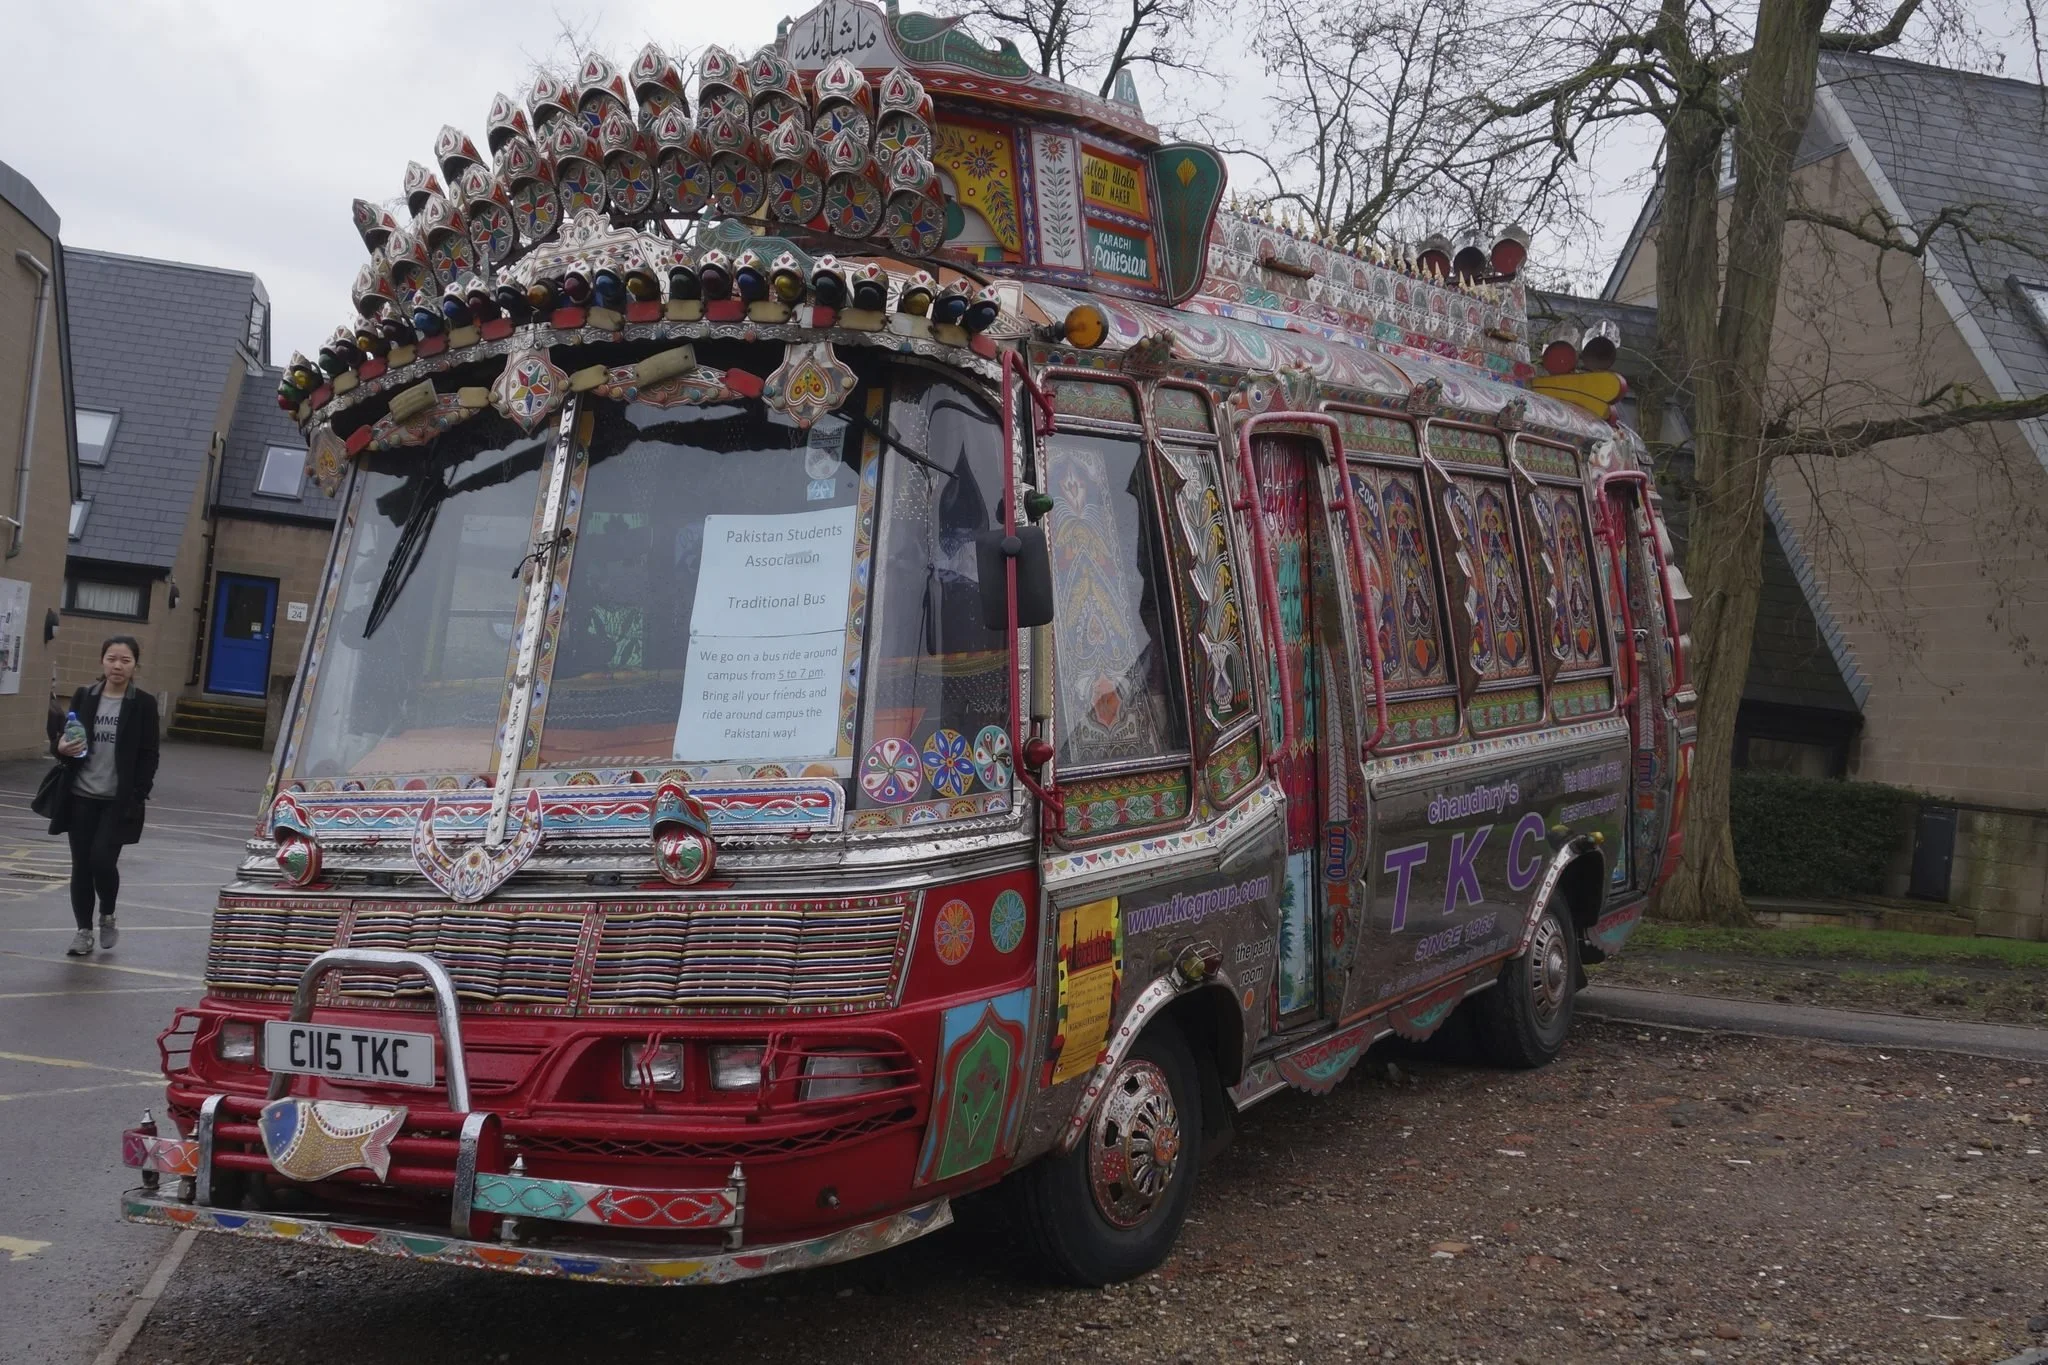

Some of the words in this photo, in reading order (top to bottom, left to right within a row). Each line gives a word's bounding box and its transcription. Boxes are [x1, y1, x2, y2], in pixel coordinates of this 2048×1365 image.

[1084, 158, 1108, 181] Allah
[1112, 166, 1136, 190] Wala
[1090, 181, 1105, 197] BODY
[1110, 186, 1131, 204] MAKER
[1098, 232, 1131, 251] KARACHI
[1357, 481, 1379, 518] 2000
[1455, 489, 1472, 520] 2000
[726, 530, 783, 543] Pakistan
[787, 525, 843, 541] Students
[744, 552, 820, 567] Association
[728, 594, 799, 609] Traditional
[803, 593, 826, 606] Bus
[291, 611, 302, 619] 24
[700, 650, 718, 661] We
[720, 653, 734, 664] go
[736, 653, 750, 662] on
[753, 653, 760, 661] a
[762, 650, 780, 661] bus
[782, 649, 801, 661] ride
[803, 646, 838, 659] around
[707, 670, 748, 683] campus
[750, 668, 776, 680] from
[778, 668, 785, 679] 5
[787, 668, 797, 679] to
[799, 668, 806, 678] 7
[702, 690, 729, 703] Bring
[731, 689, 744, 701] all
[746, 690, 770, 703] your
[773, 687, 806, 701] friends
[809, 687, 827, 698] and
[702, 709, 722, 720] ride
[725, 708, 763, 720] around
[765, 708, 804, 722] campus
[806, 706, 822, 718] the
[724, 727, 770, 740] Pakistani
[773, 727, 797, 740] way!
[1427, 779, 1519, 825] chaudhry's
[1127, 875, 1271, 936] www.tkcgroup.com
[1235, 943, 1250, 963] the
[1250, 936, 1274, 962] party
[1415, 924, 1463, 961] SINCE
[1239, 965, 1264, 987] room
[290, 1029, 342, 1070] C115
[351, 1034, 409, 1078] TKC
